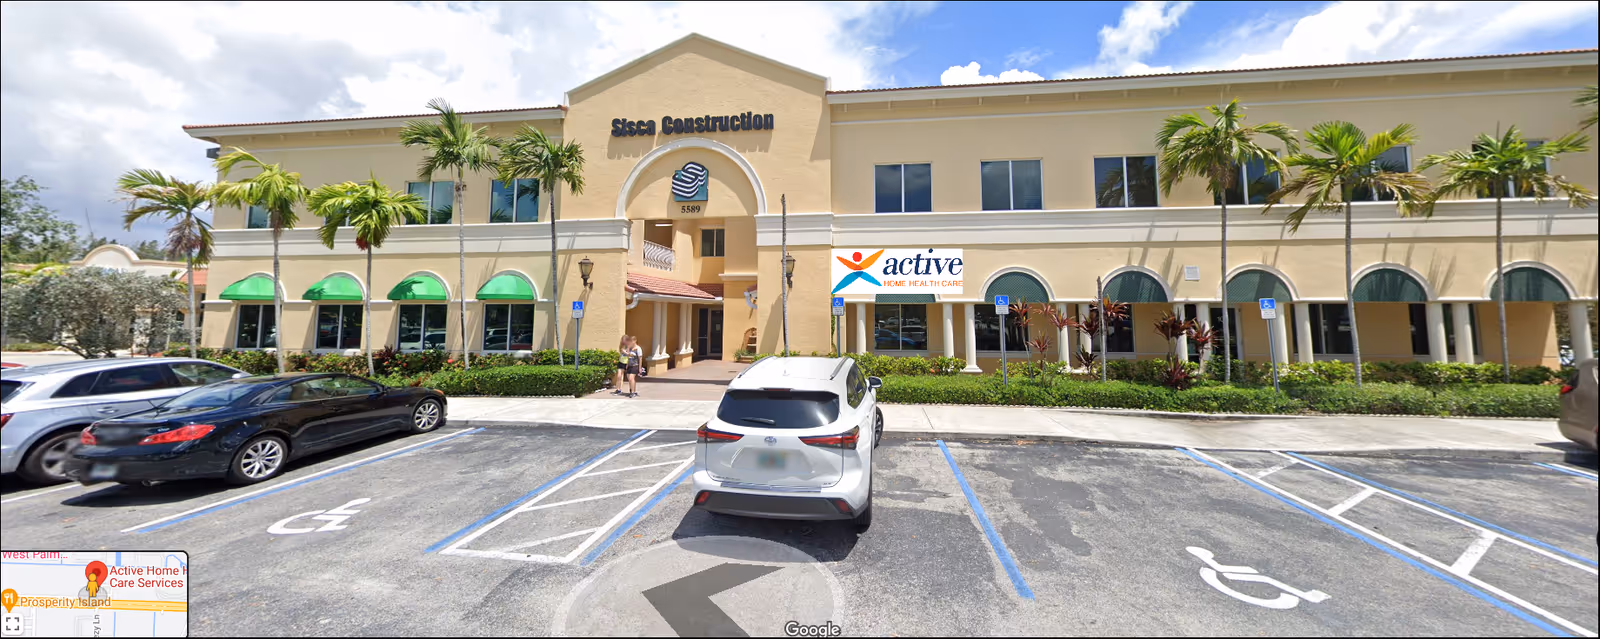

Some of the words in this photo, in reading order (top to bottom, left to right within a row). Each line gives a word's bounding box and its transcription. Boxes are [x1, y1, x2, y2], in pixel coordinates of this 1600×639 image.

[611, 118, 656, 137] Sisca
[661, 111, 774, 135] Construction
[681, 205, 701, 214] 5589
[882, 248, 963, 275] active
